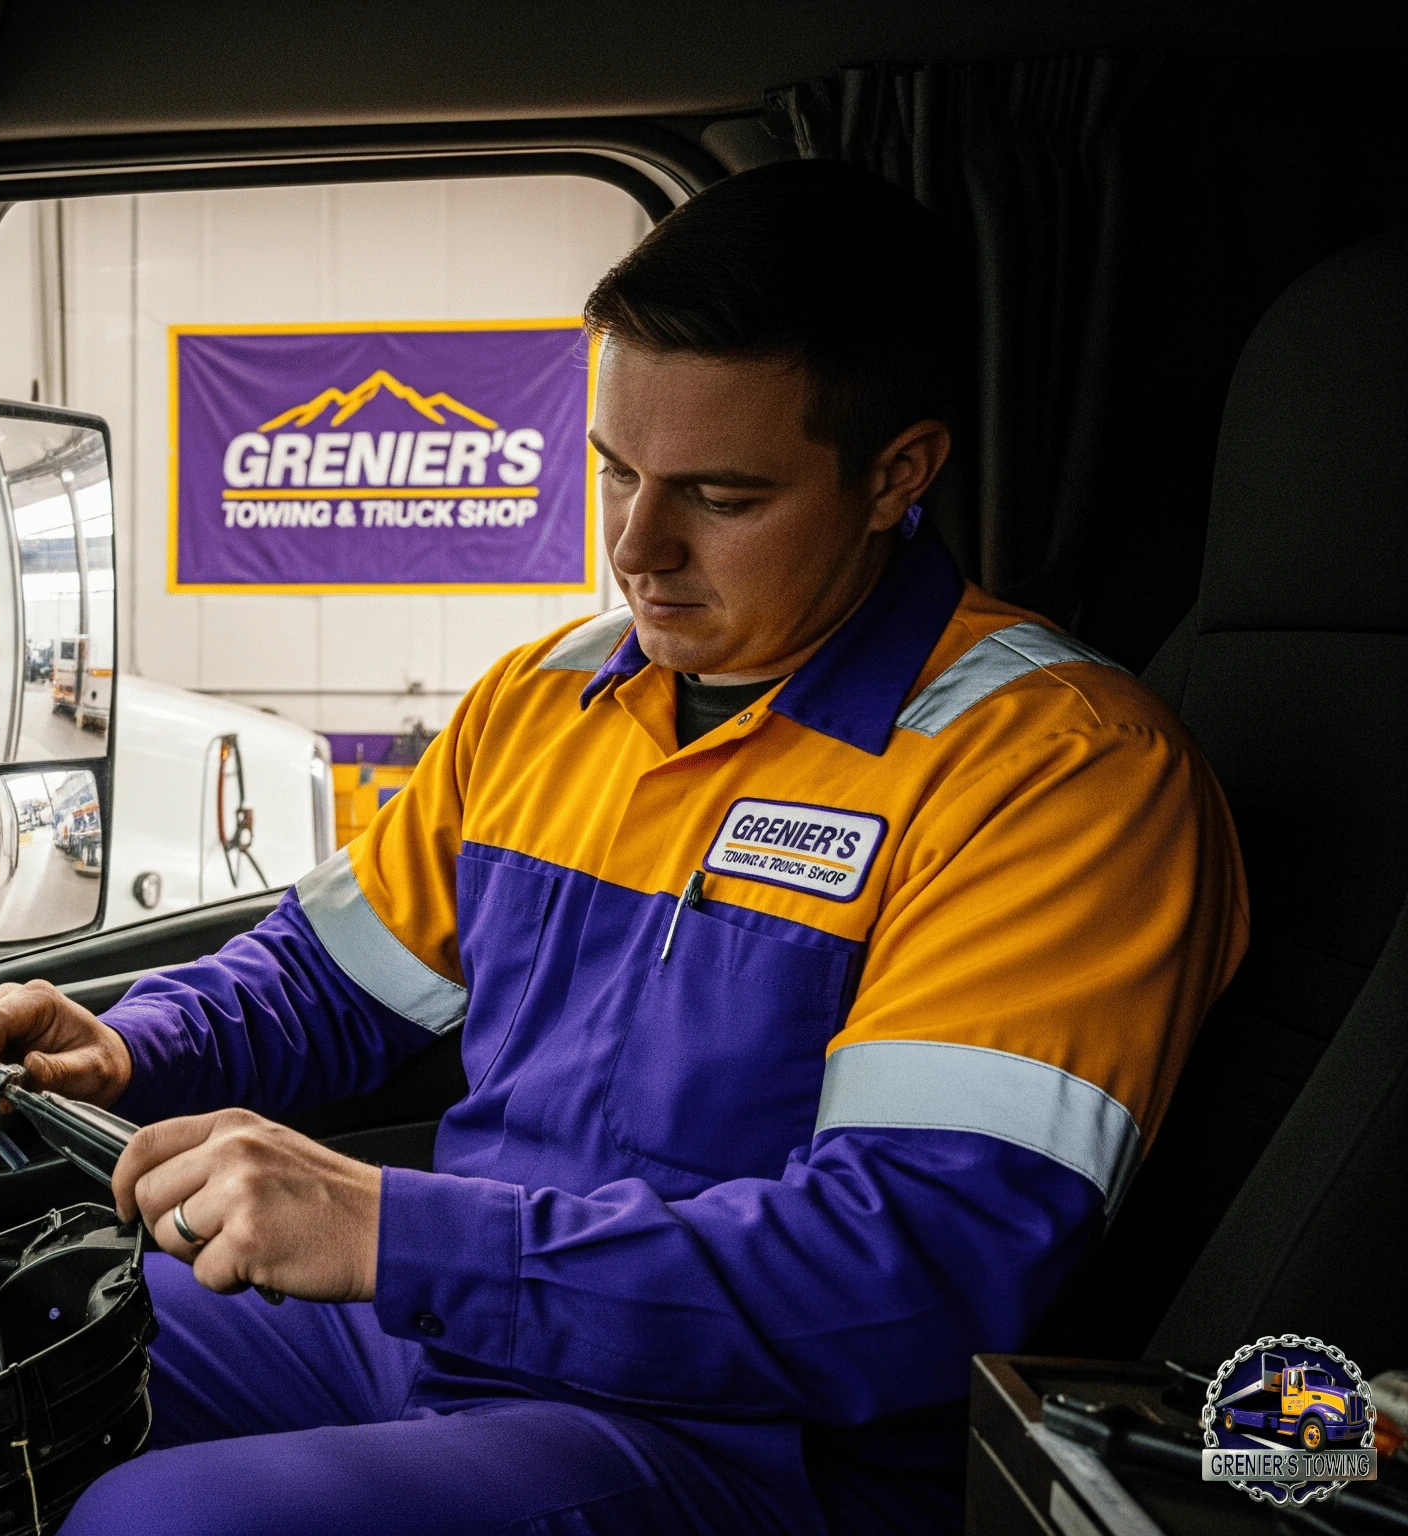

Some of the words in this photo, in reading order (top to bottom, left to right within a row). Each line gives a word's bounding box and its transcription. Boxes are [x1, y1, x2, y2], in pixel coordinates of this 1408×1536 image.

[223, 428, 545, 488] GRENIER'S
[221, 500, 332, 528] TOWING
[334, 500, 357, 528] &
[360, 499, 456, 528] TRUCK
[457, 498, 538, 528] SHOP
[731, 814, 861, 859] GRENIER'S
[808, 865, 847, 886] SHOP
